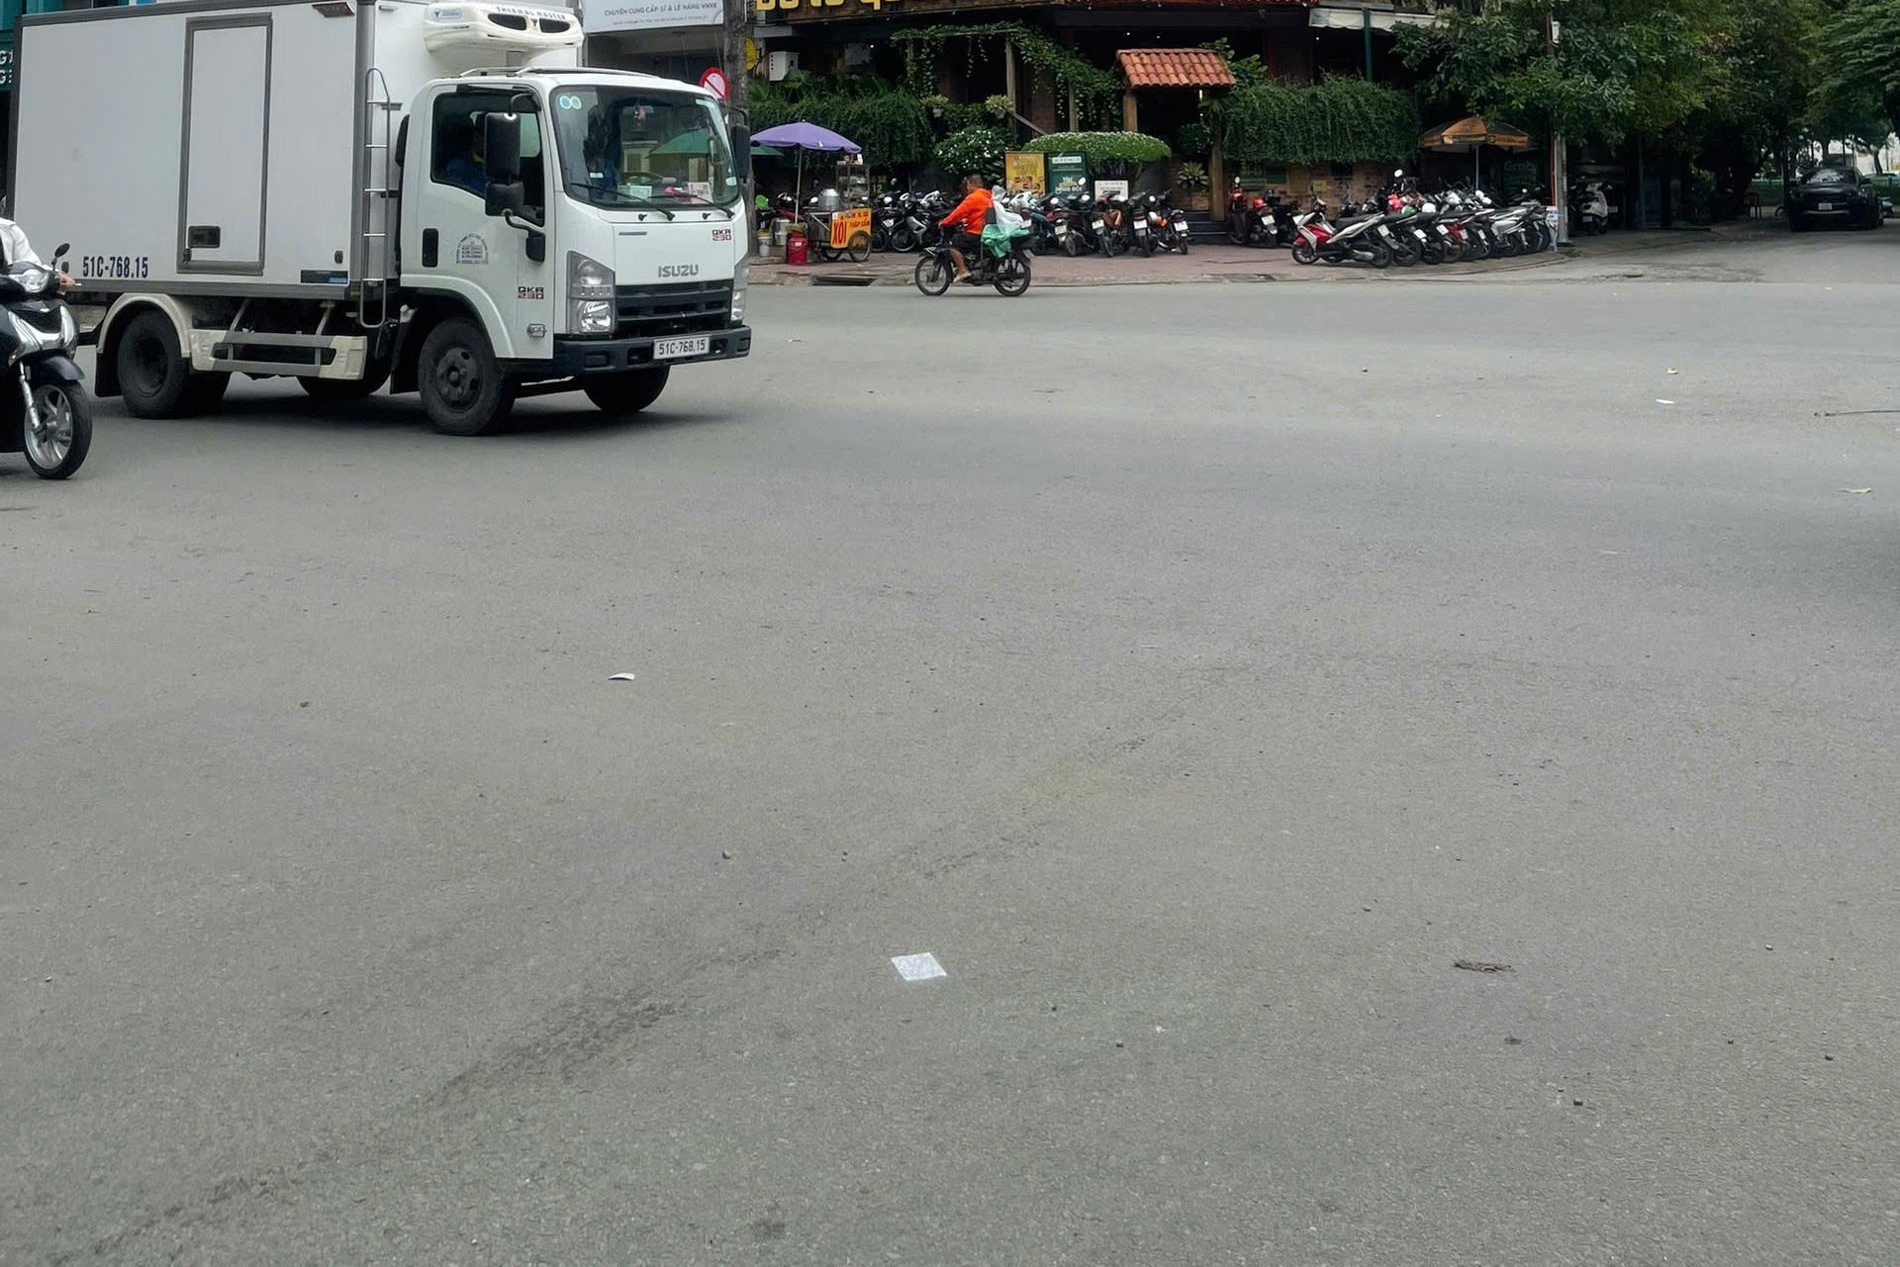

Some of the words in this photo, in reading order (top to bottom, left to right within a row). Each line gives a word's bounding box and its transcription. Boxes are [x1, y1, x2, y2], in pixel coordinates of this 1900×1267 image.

[83, 255, 148, 278] 51C-768.15
[658, 264, 699, 278] ISUZU
[658, 339, 706, 355] 51C-768.15
